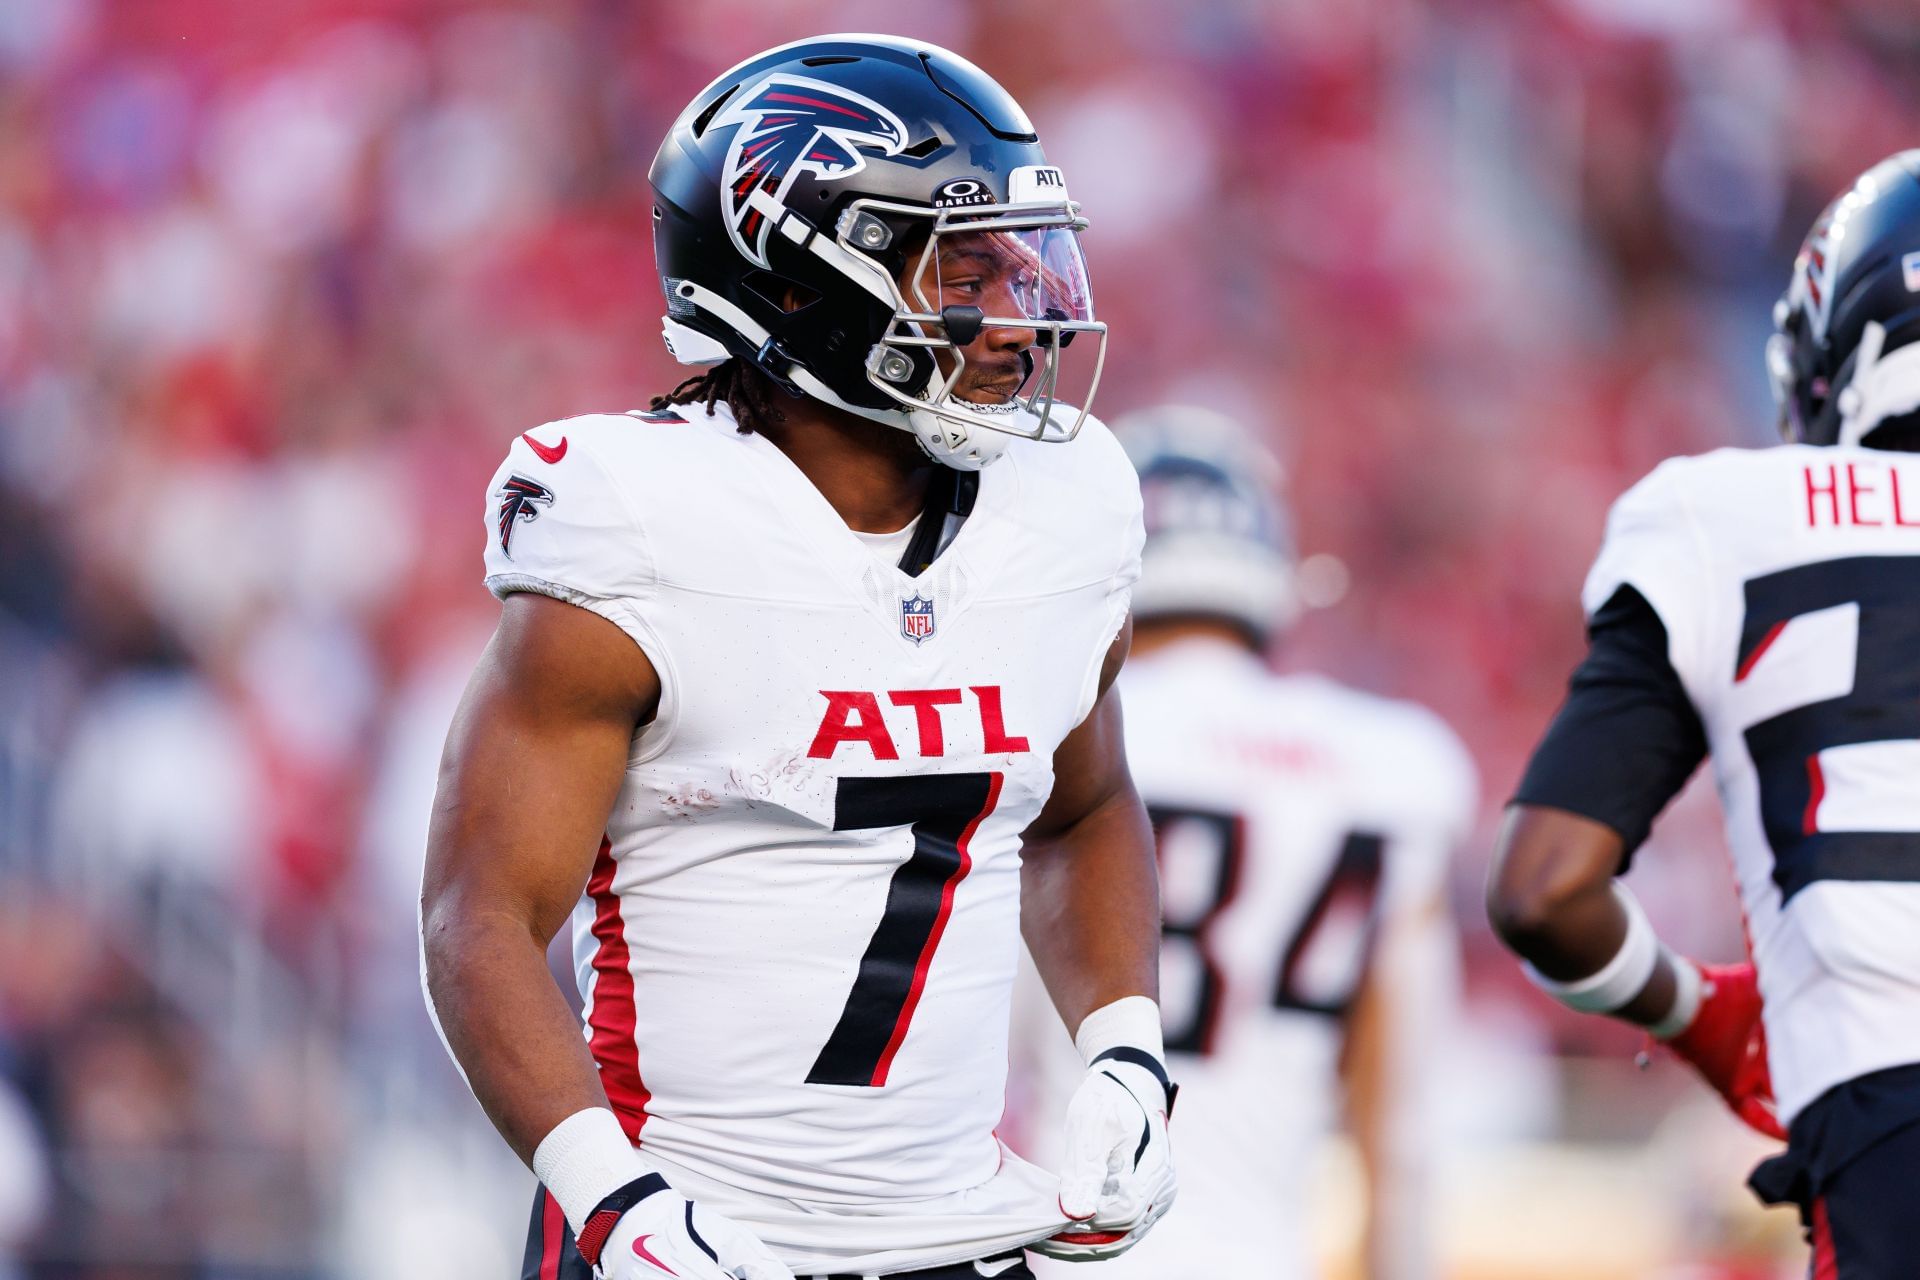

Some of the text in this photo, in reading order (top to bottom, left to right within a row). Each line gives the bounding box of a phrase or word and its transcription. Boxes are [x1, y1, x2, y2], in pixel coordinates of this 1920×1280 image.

[1035, 169, 1063, 187] ATL
[935, 193, 988, 208] OAKLEY
[1805, 463, 1920, 527] HEL
[906, 615, 932, 636] NFL
[806, 685, 1030, 761] ATL
[803, 771, 1004, 1086] 7
